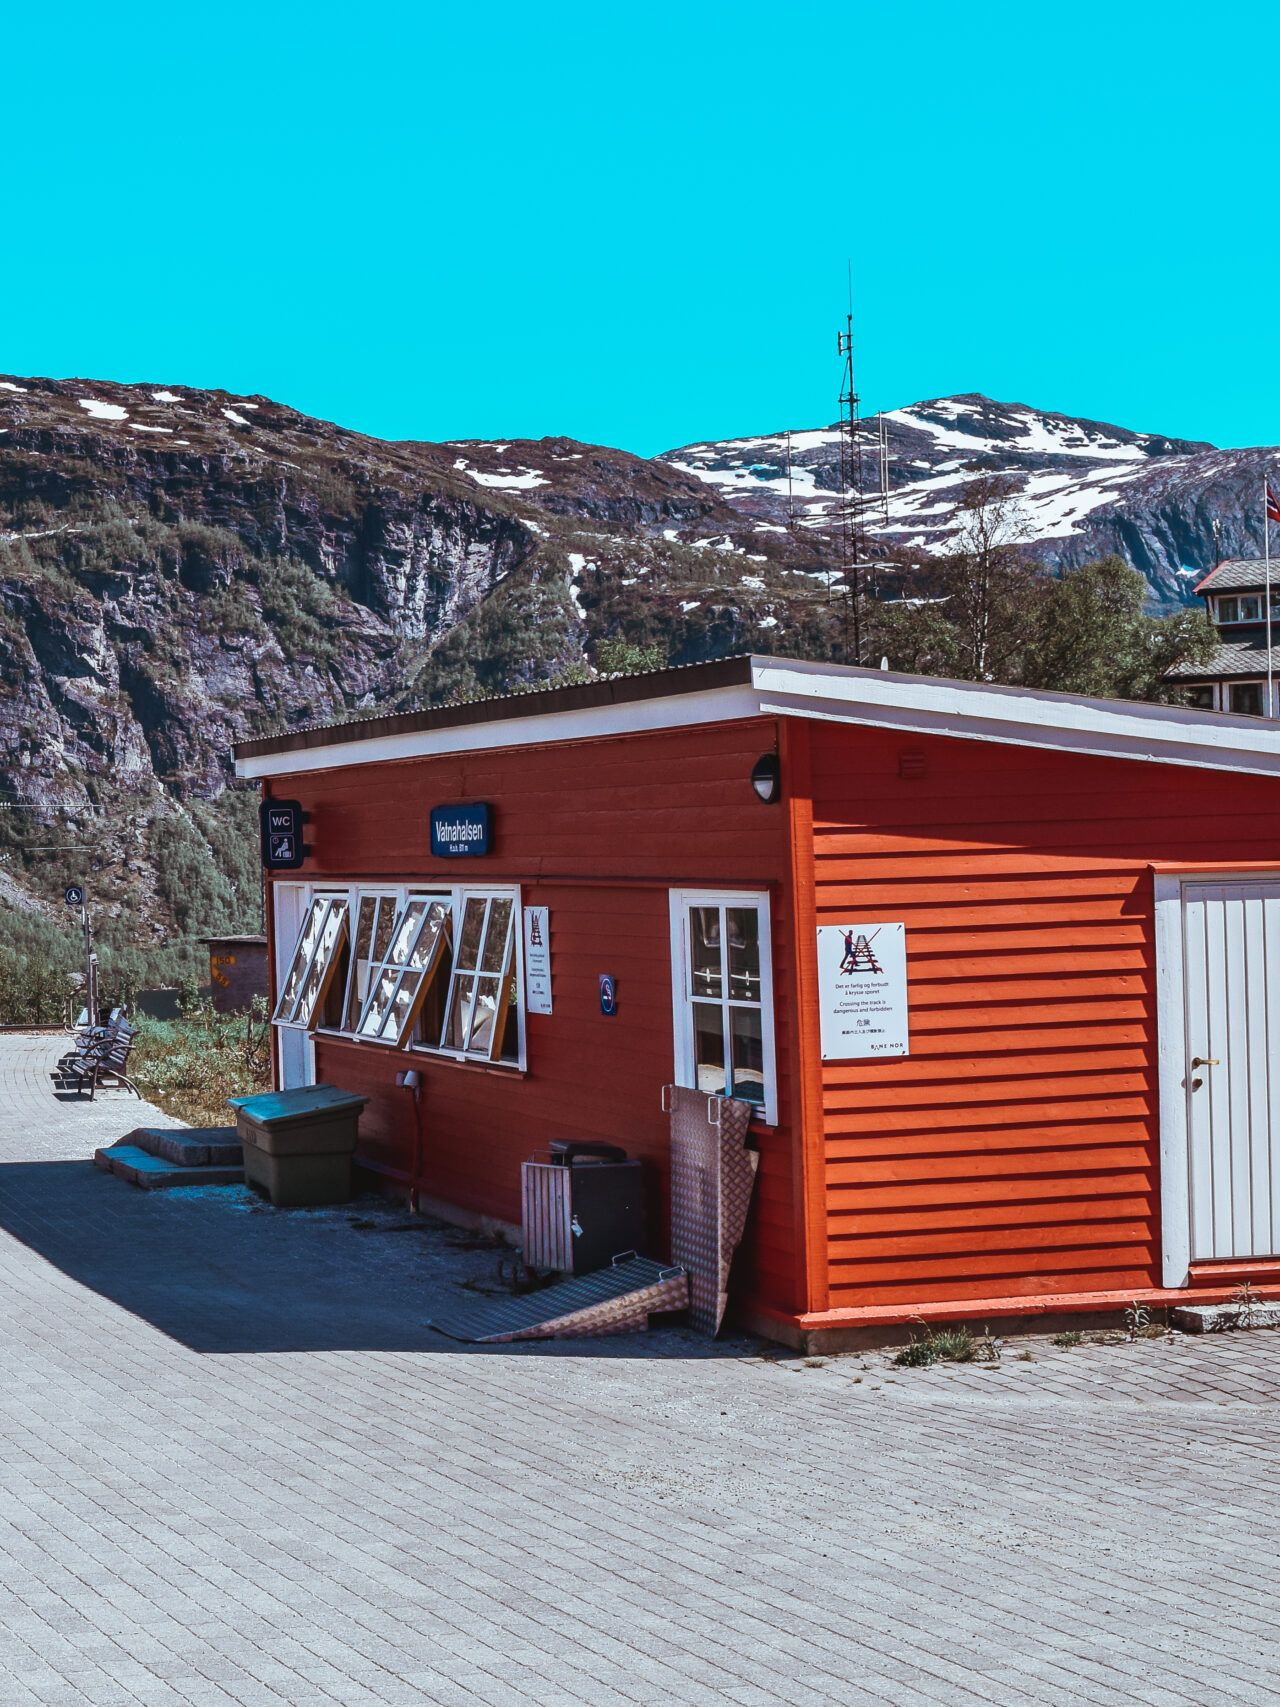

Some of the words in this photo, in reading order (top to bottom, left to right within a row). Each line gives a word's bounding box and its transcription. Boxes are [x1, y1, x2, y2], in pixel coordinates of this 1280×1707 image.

[272, 816, 290, 826] WC
[435, 819, 483, 842] Vatnahalsen
[216, 956, 230, 965] 150
